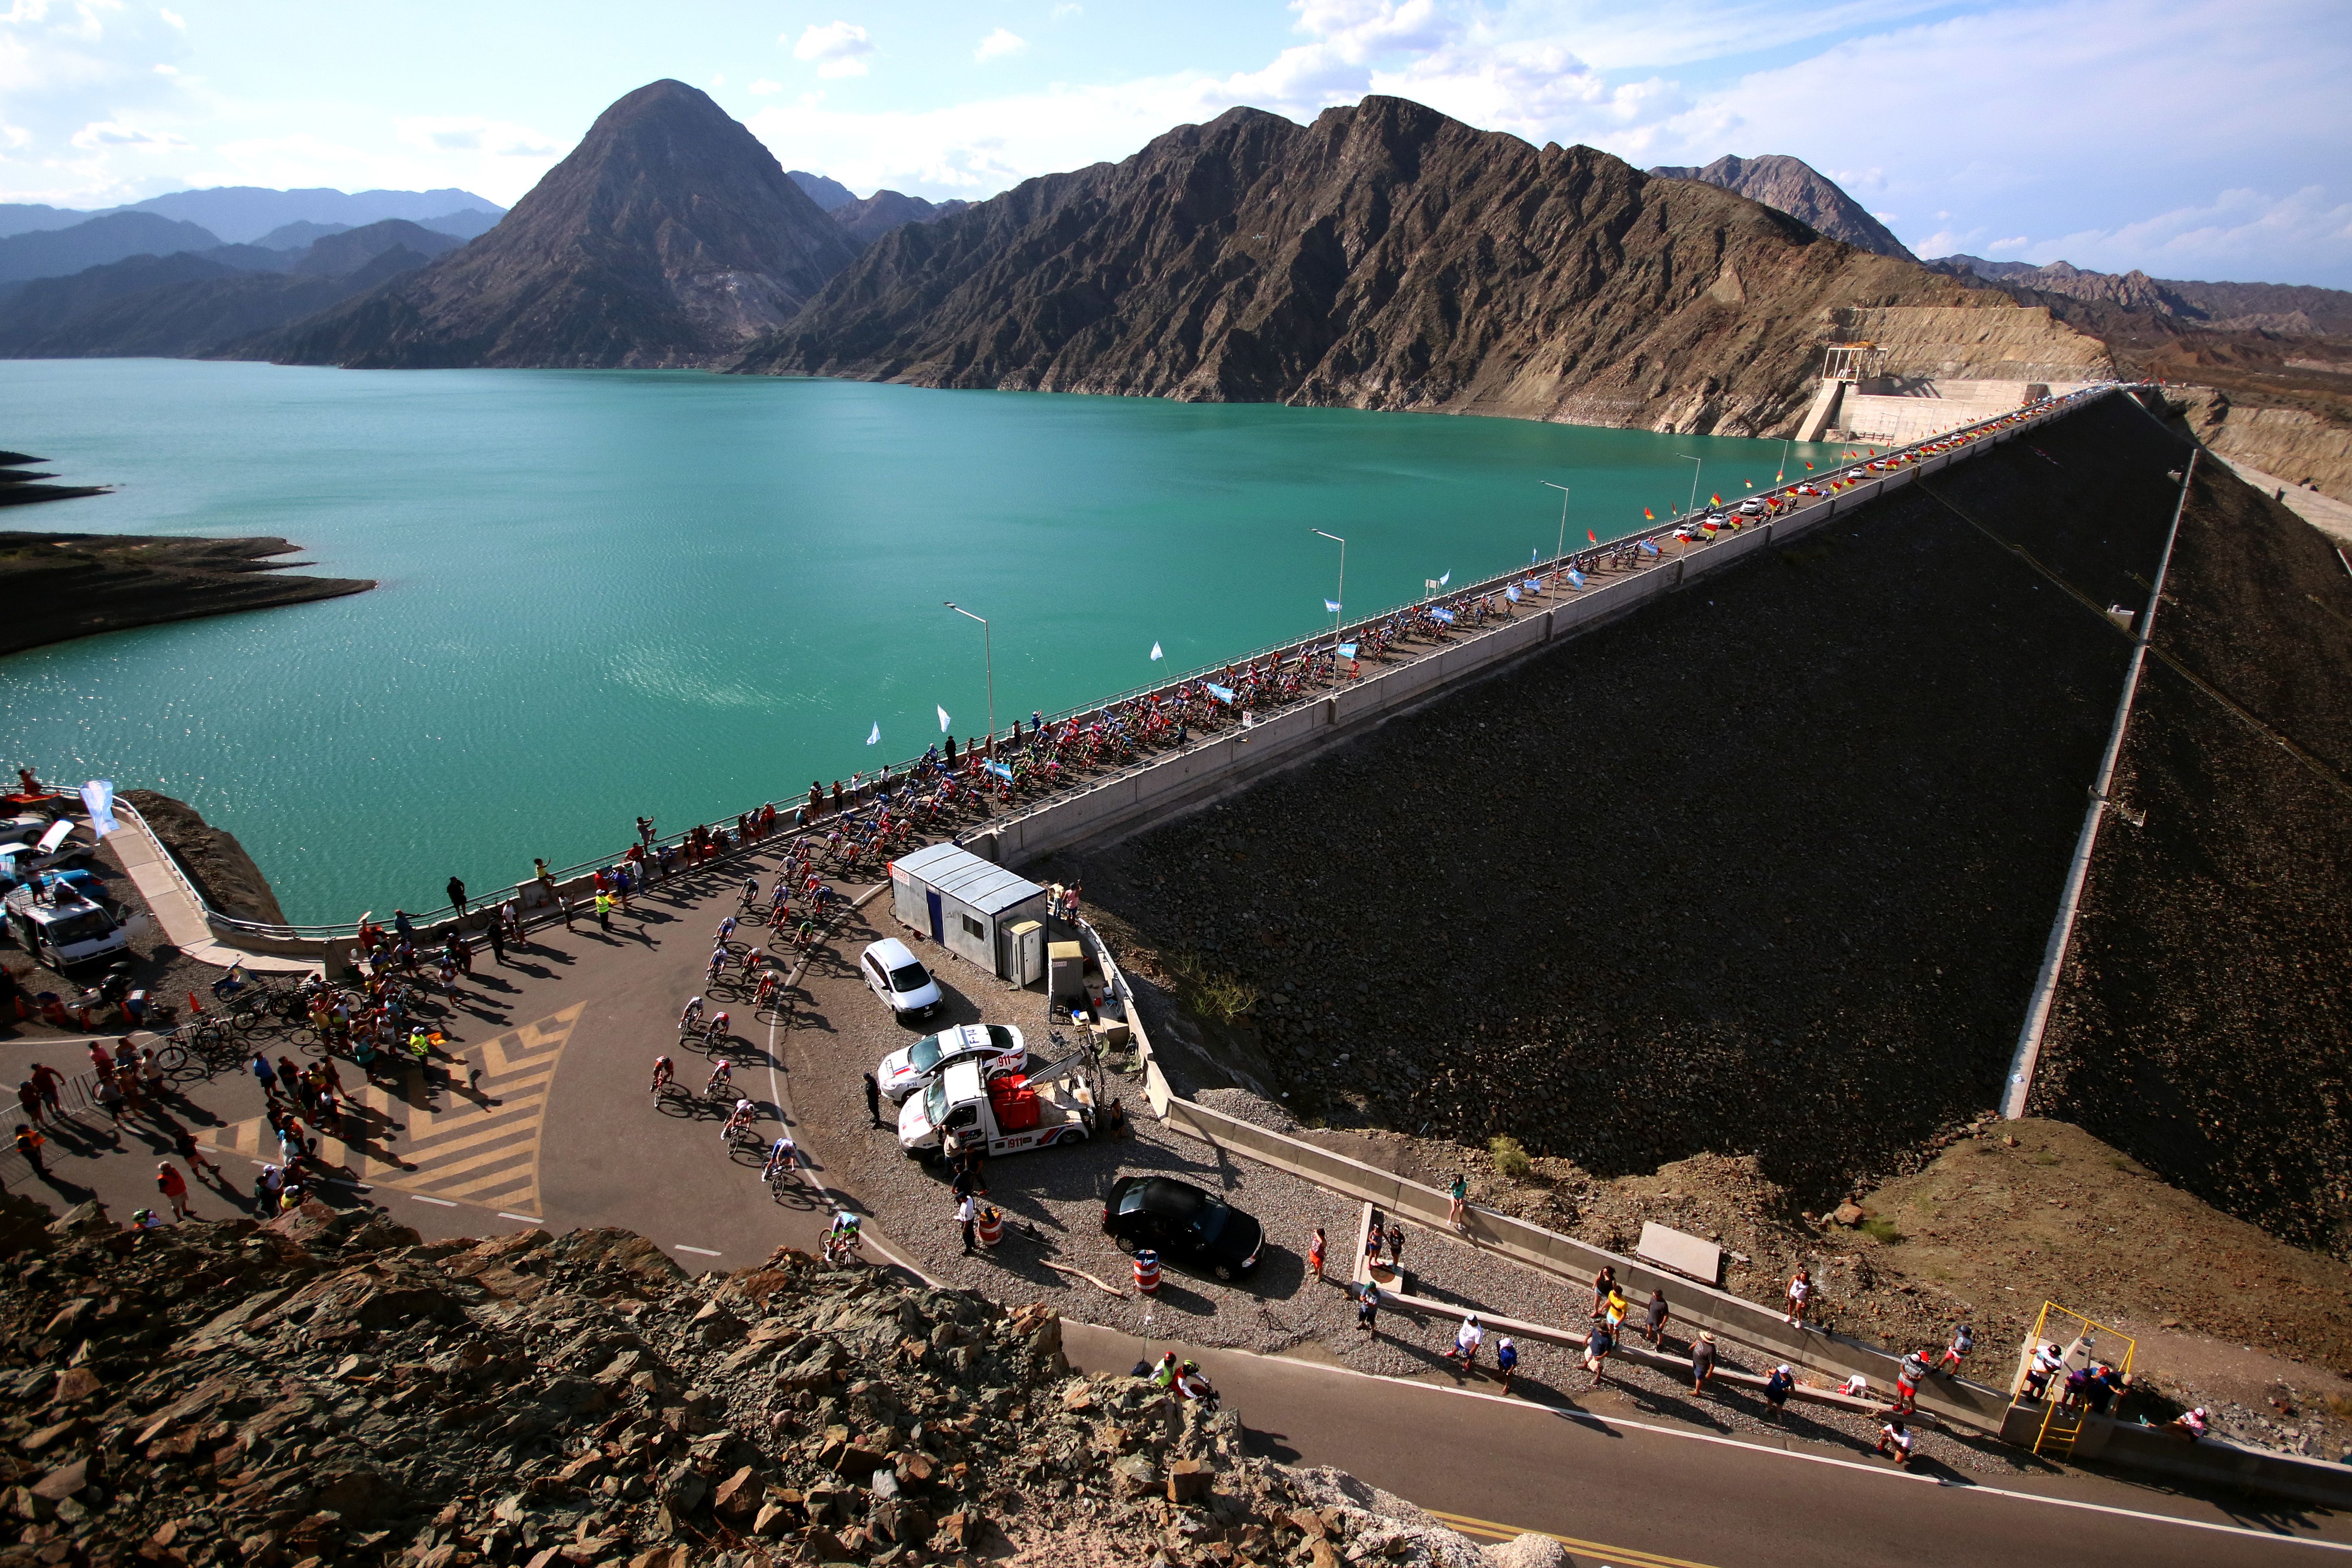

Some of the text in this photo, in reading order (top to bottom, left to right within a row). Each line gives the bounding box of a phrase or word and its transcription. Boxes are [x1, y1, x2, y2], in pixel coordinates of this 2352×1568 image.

[967, 1029, 980, 1044] F-14
[998, 1054, 1011, 1067] 911
[1010, 1137, 1023, 1148] 911
